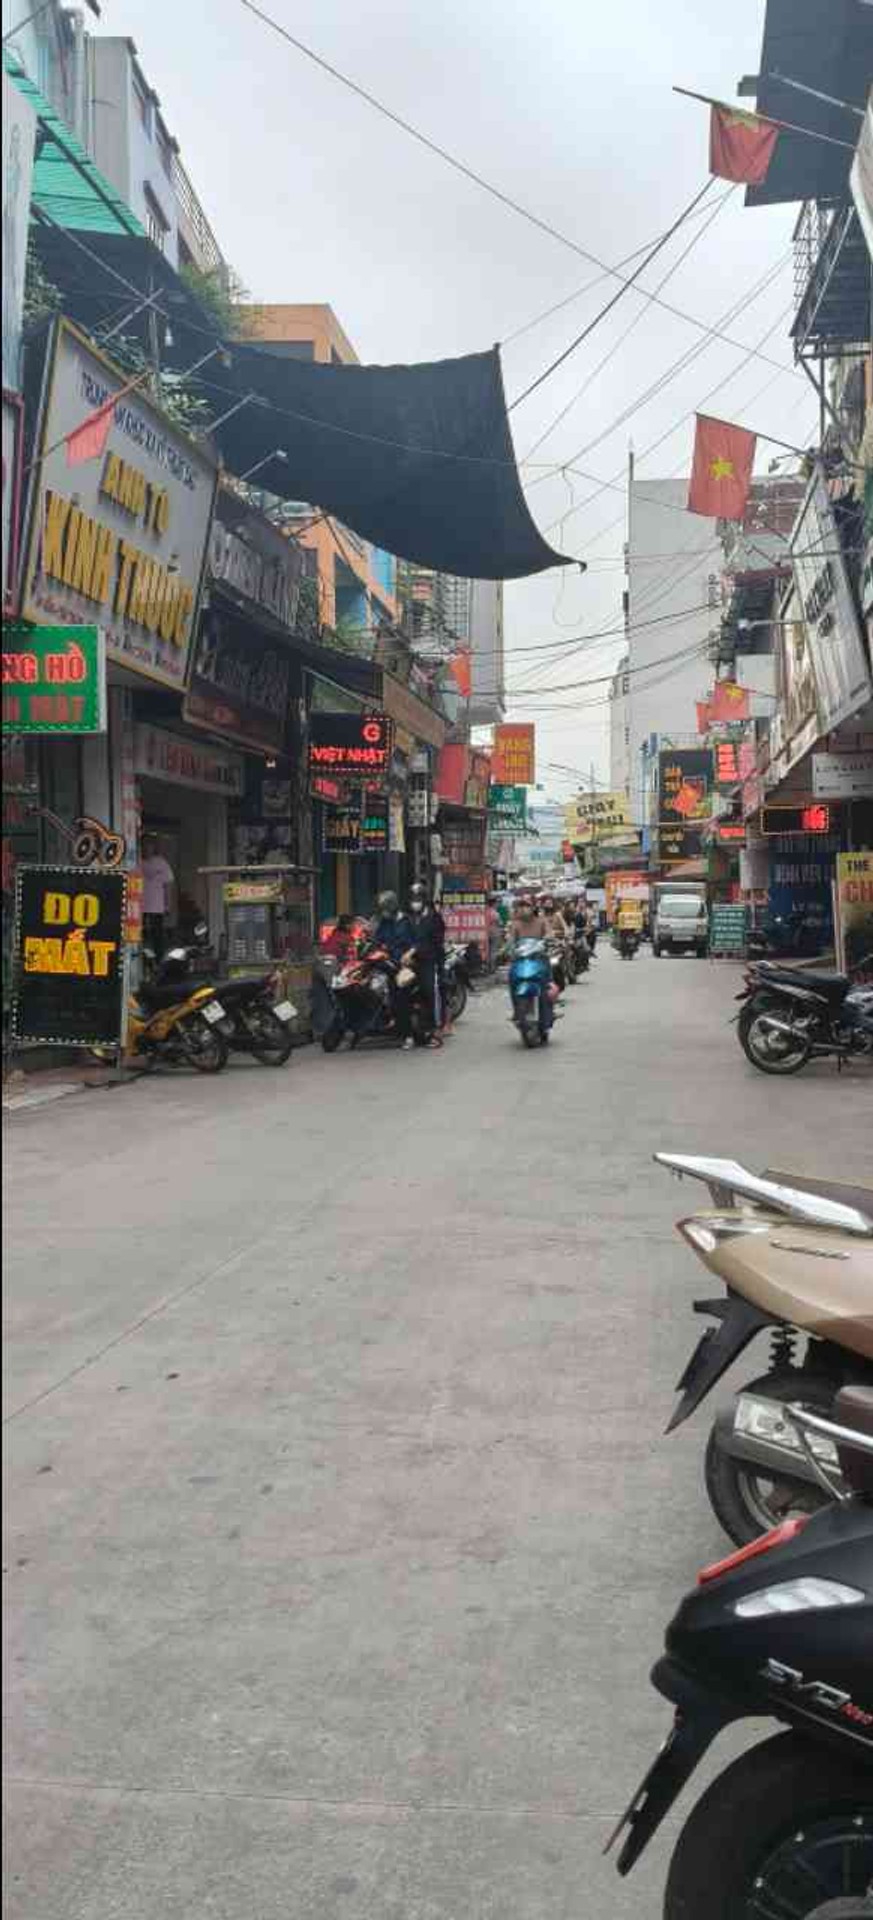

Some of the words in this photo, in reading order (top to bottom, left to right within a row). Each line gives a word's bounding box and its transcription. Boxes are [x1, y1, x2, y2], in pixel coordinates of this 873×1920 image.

[43, 489, 114, 602] KÍNH
[114, 540, 192, 648] THUỐC
[45, 640, 86, 683] HỒ
[347, 747, 386, 765] NHẬT
